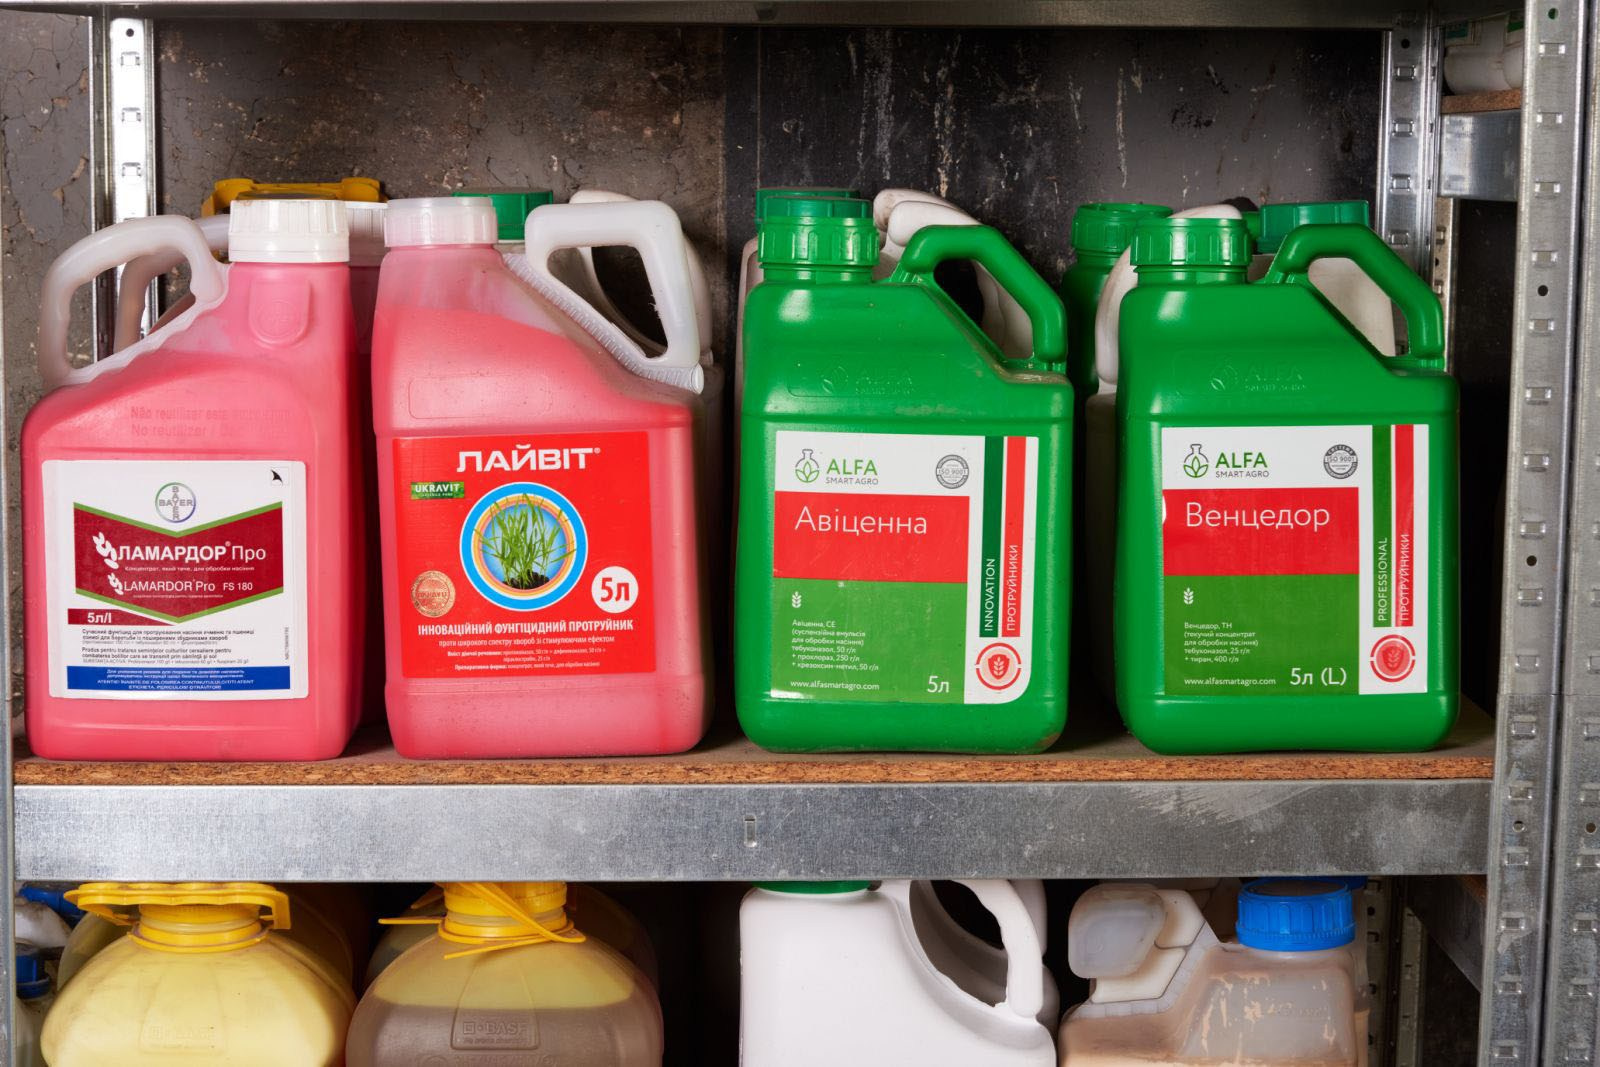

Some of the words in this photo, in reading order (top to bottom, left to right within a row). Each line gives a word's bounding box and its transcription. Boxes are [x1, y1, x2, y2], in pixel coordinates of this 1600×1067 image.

[1215, 452, 1268, 469] ALFA
[826, 458, 878, 476] ALFA
[1215, 470, 1244, 478] SMART
[1245, 470, 1270, 478] AGRO
[825, 477, 854, 485] SMART
[854, 477, 879, 486] AGRO
[415, 483, 460, 493] UKRAVIT
[159, 499, 193, 507] BAYER
[794, 506, 928, 536] Авіценна
[1186, 502, 1331, 532] Венцедор
[232, 546, 267, 563] Про
[1378, 537, 1388, 621] PROFESSIONAL
[1399, 534, 1410, 621] ПРОТРУЙНИКИ
[124, 581, 193, 592] LAMARDOR
[195, 581, 216, 592] Pro
[223, 582, 235, 592] FS
[237, 582, 254, 592] 180
[599, 577, 630, 603] 5л
[1006, 544, 1019, 631] ПРОТРУЙНИКИ
[984, 558, 996, 632] INNOVATION
[418, 622, 493, 637] ІННОВАЦІЙНИЙ
[494, 620, 567, 636] ФУНГІЦИДНИЙ
[568, 619, 634, 632] ПРОТРУЙНИК
[792, 619, 826, 628] Авіценна,
[1184, 622, 1222, 630] Венцедор,
[792, 628, 836, 637] (суспензійна
[1184, 631, 1214, 639] (текучий
[438, 640, 458, 648] проти
[457, 639, 488, 648] широкого
[488, 638, 512, 648] спектру
[513, 638, 536, 646] хвороб
[804, 637, 836, 645] обробки
[1229, 639, 1259, 647] насіння)
[836, 646, 845, 654] 50
[868, 664, 880, 672] г/л
[1184, 677, 1277, 687] www.alfasmartagro.com
[1290, 667, 1314, 686] 5л
[1320, 667, 1347, 686] (L)
[790, 680, 880, 692] www.alfasmartagro.com
[926, 675, 950, 694] 5л
